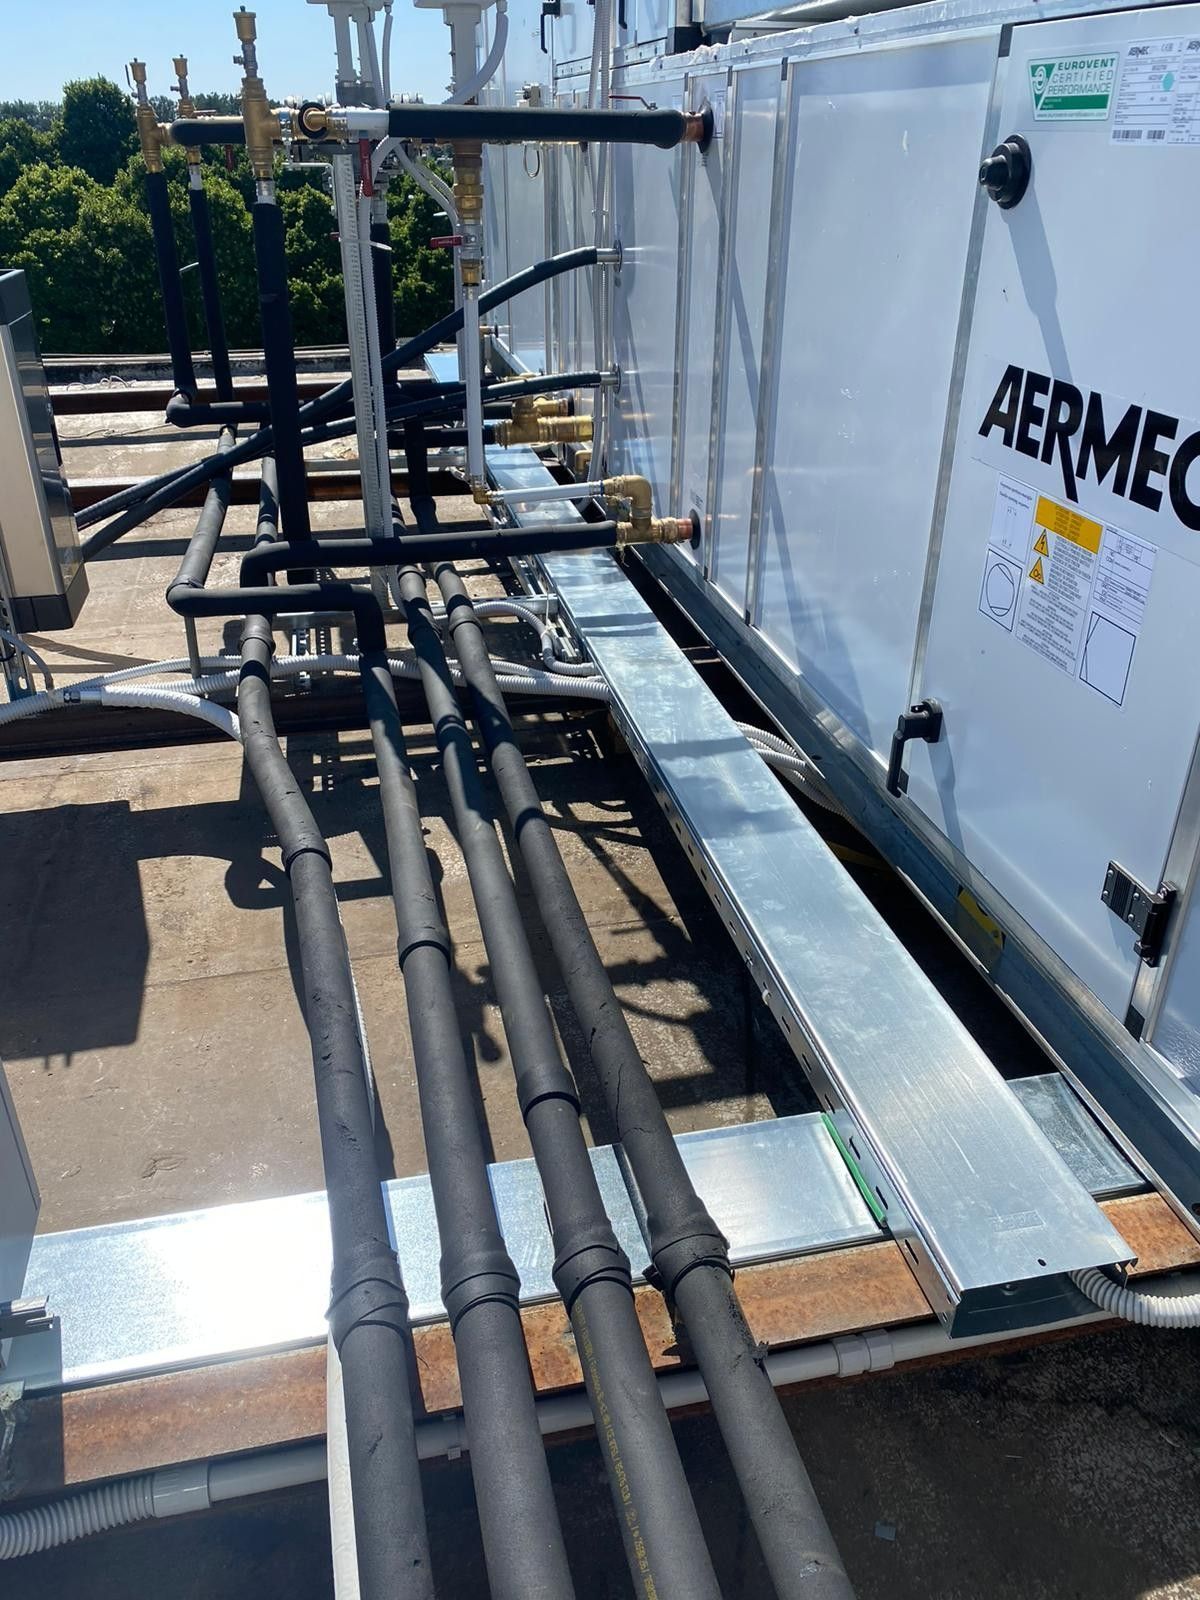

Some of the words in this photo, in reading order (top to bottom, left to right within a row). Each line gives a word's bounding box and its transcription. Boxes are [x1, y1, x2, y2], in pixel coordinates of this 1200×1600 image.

[1058, 57, 1116, 71] EUROVENT
[1052, 69, 1113, 84] CERTIFIED
[1047, 82, 1112, 96] PERFORMANCE
[978, 364, 1200, 531] AERMEC
